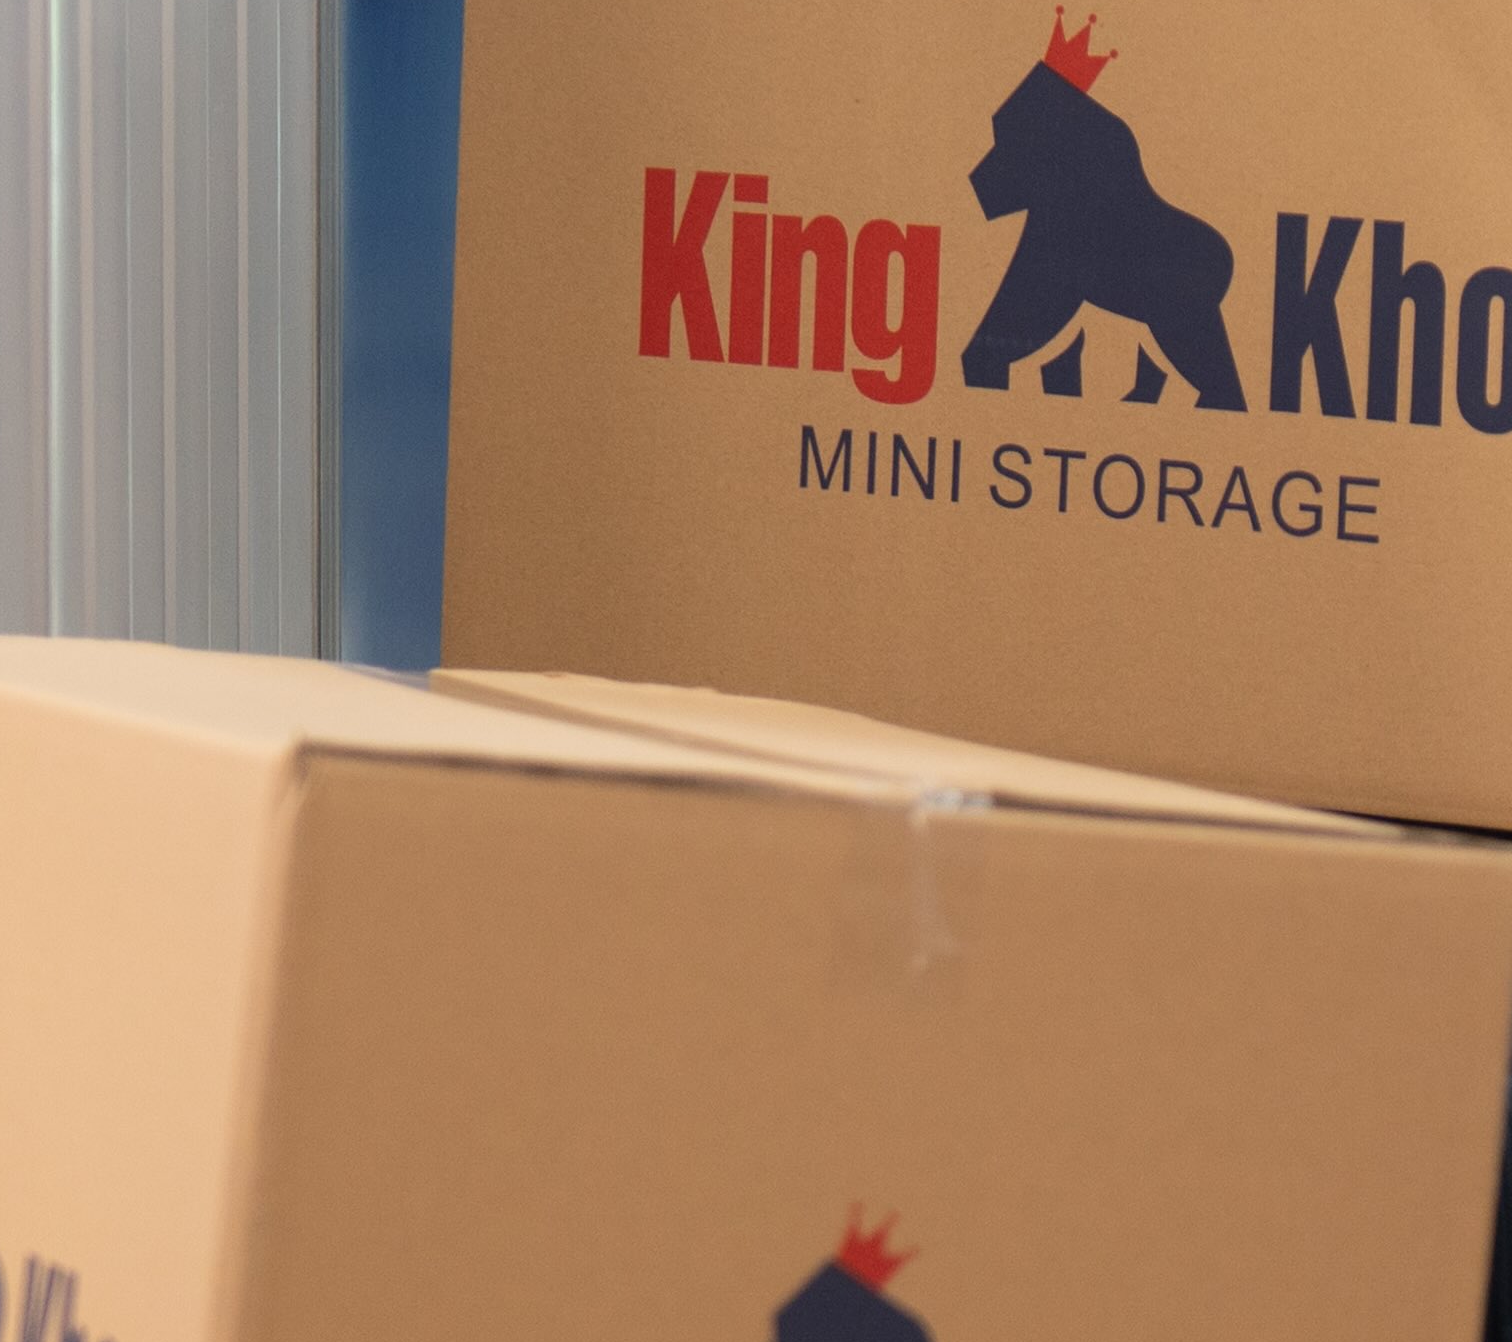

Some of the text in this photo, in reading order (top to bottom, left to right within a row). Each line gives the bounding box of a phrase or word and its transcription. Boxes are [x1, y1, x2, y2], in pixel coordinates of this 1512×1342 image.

[638, 167, 942, 405] King
[798, 424, 1381, 544] MINI STORAGE
